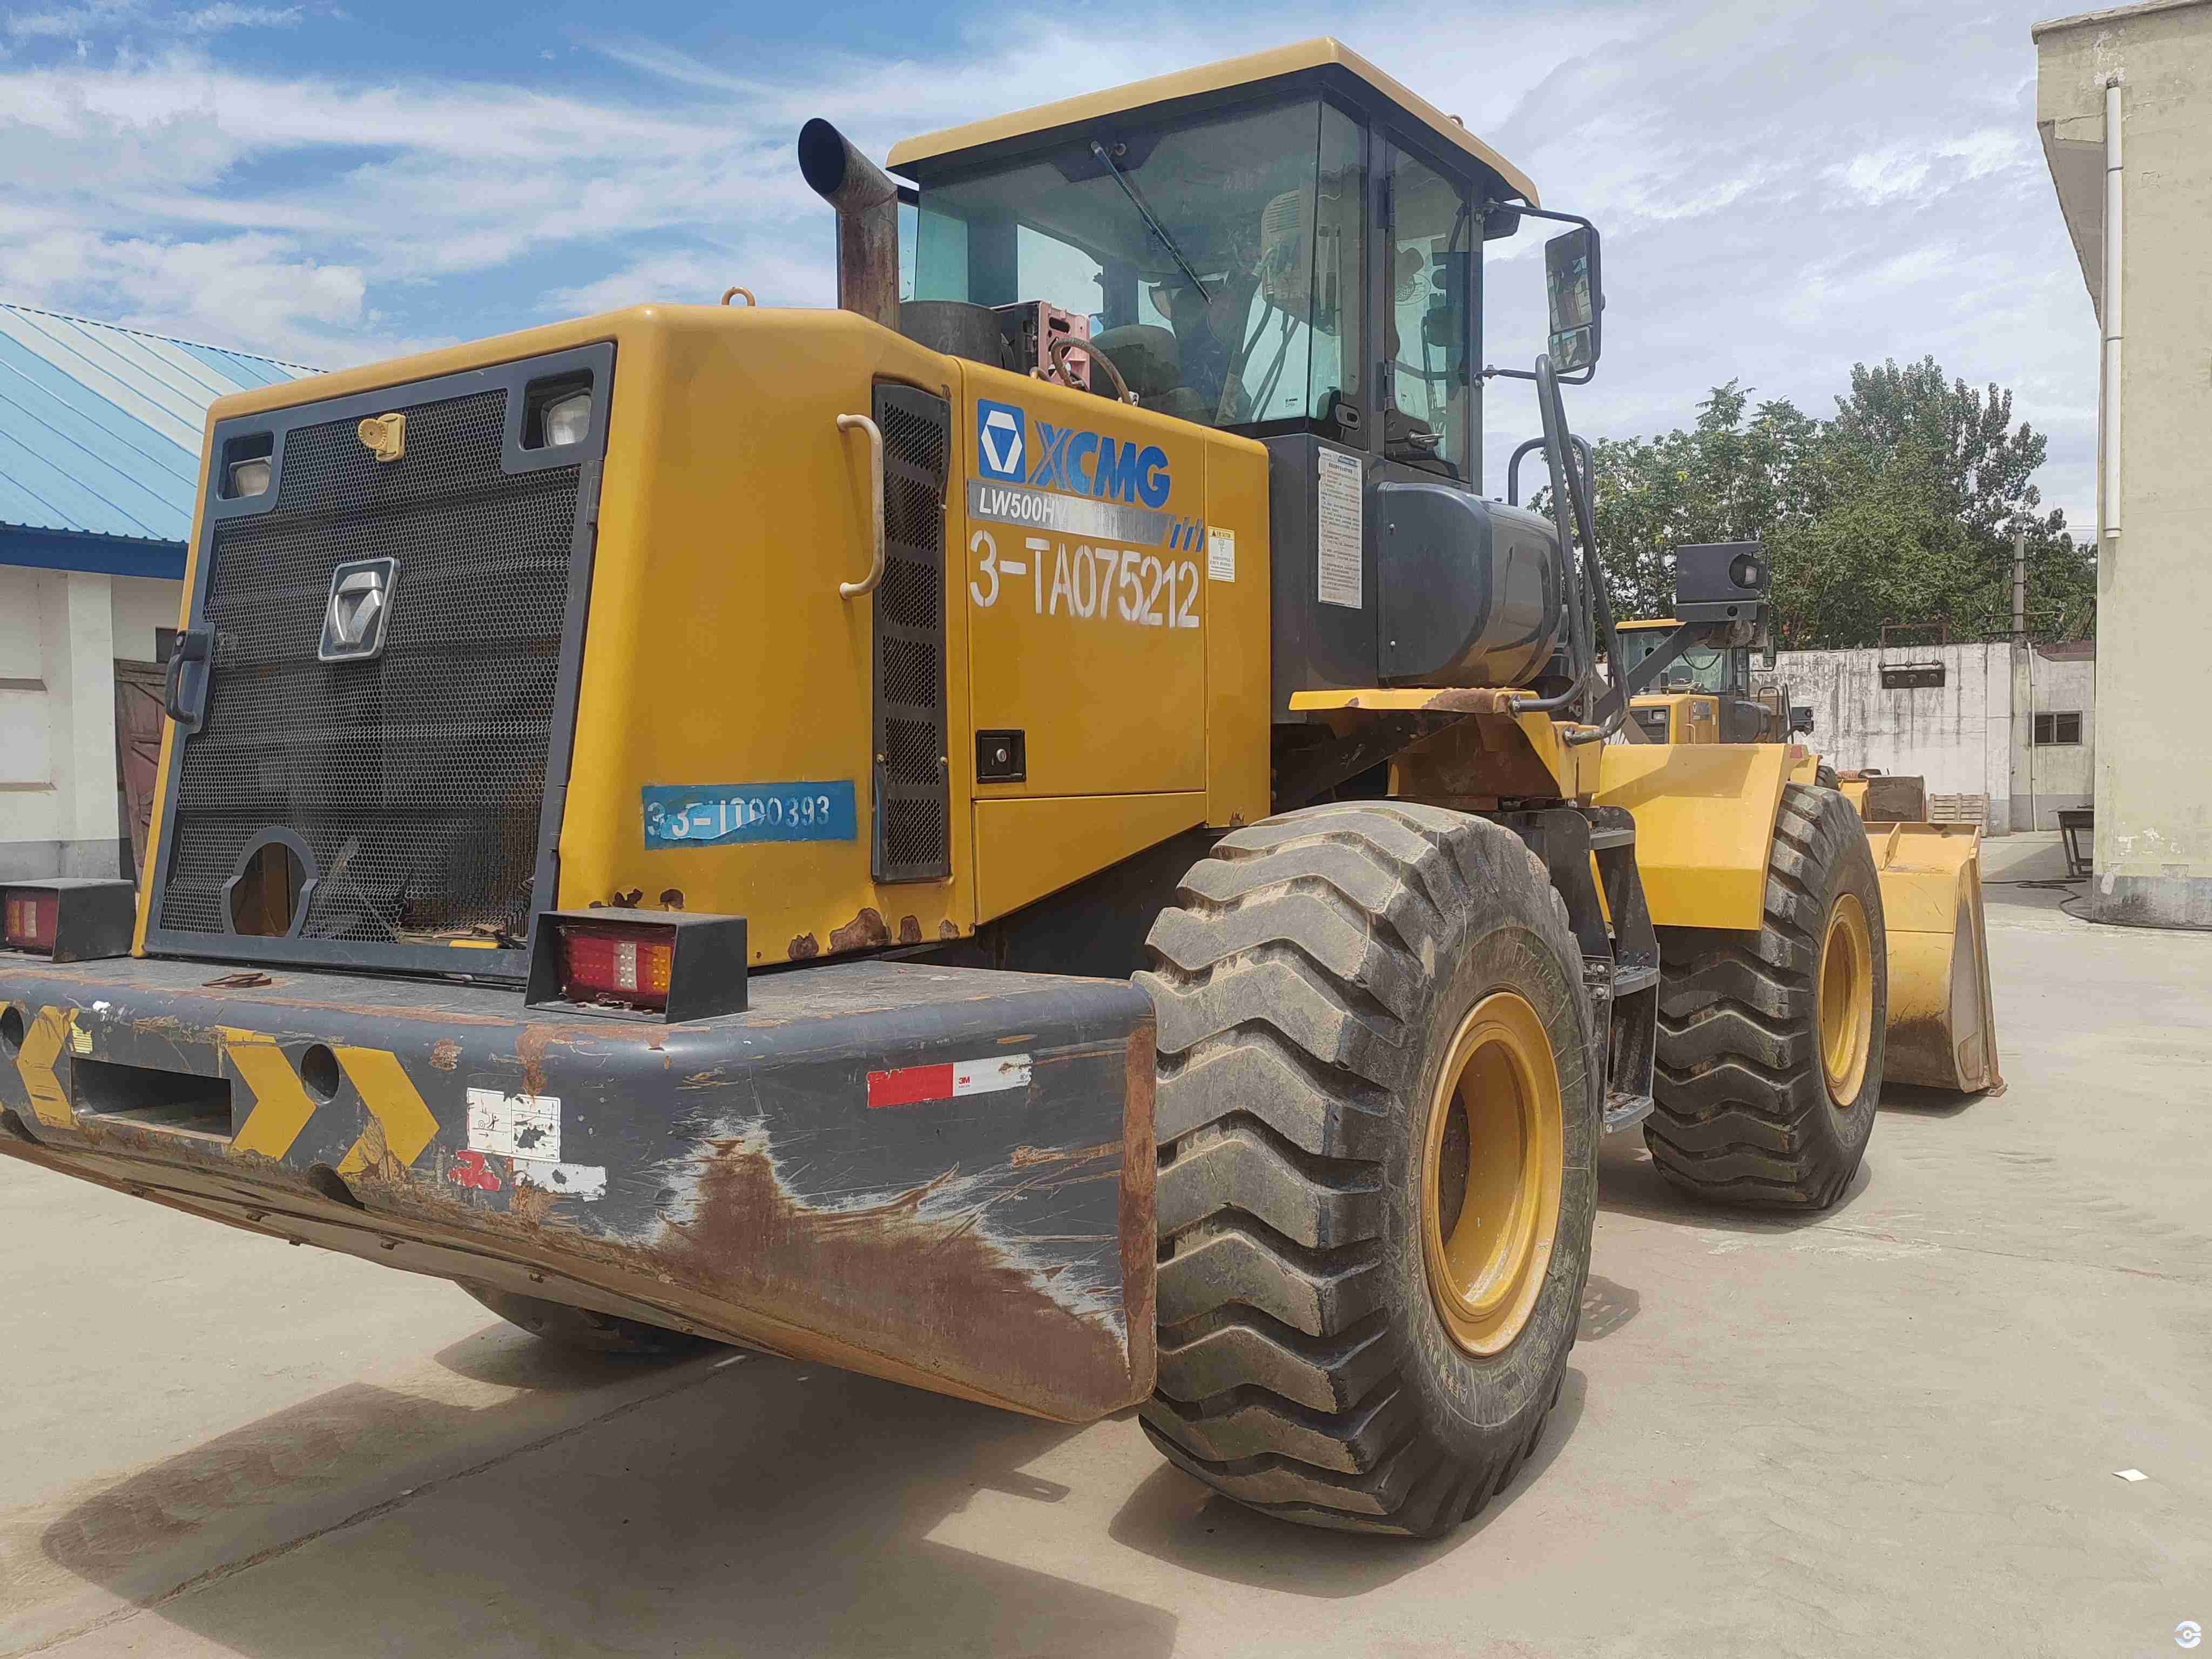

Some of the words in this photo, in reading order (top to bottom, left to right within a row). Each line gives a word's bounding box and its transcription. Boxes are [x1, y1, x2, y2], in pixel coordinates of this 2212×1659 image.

[1028, 420, 1171, 508] XCMG
[970, 530, 1199, 629] 3-TA075212
[959, 1076, 970, 1084] 3M
